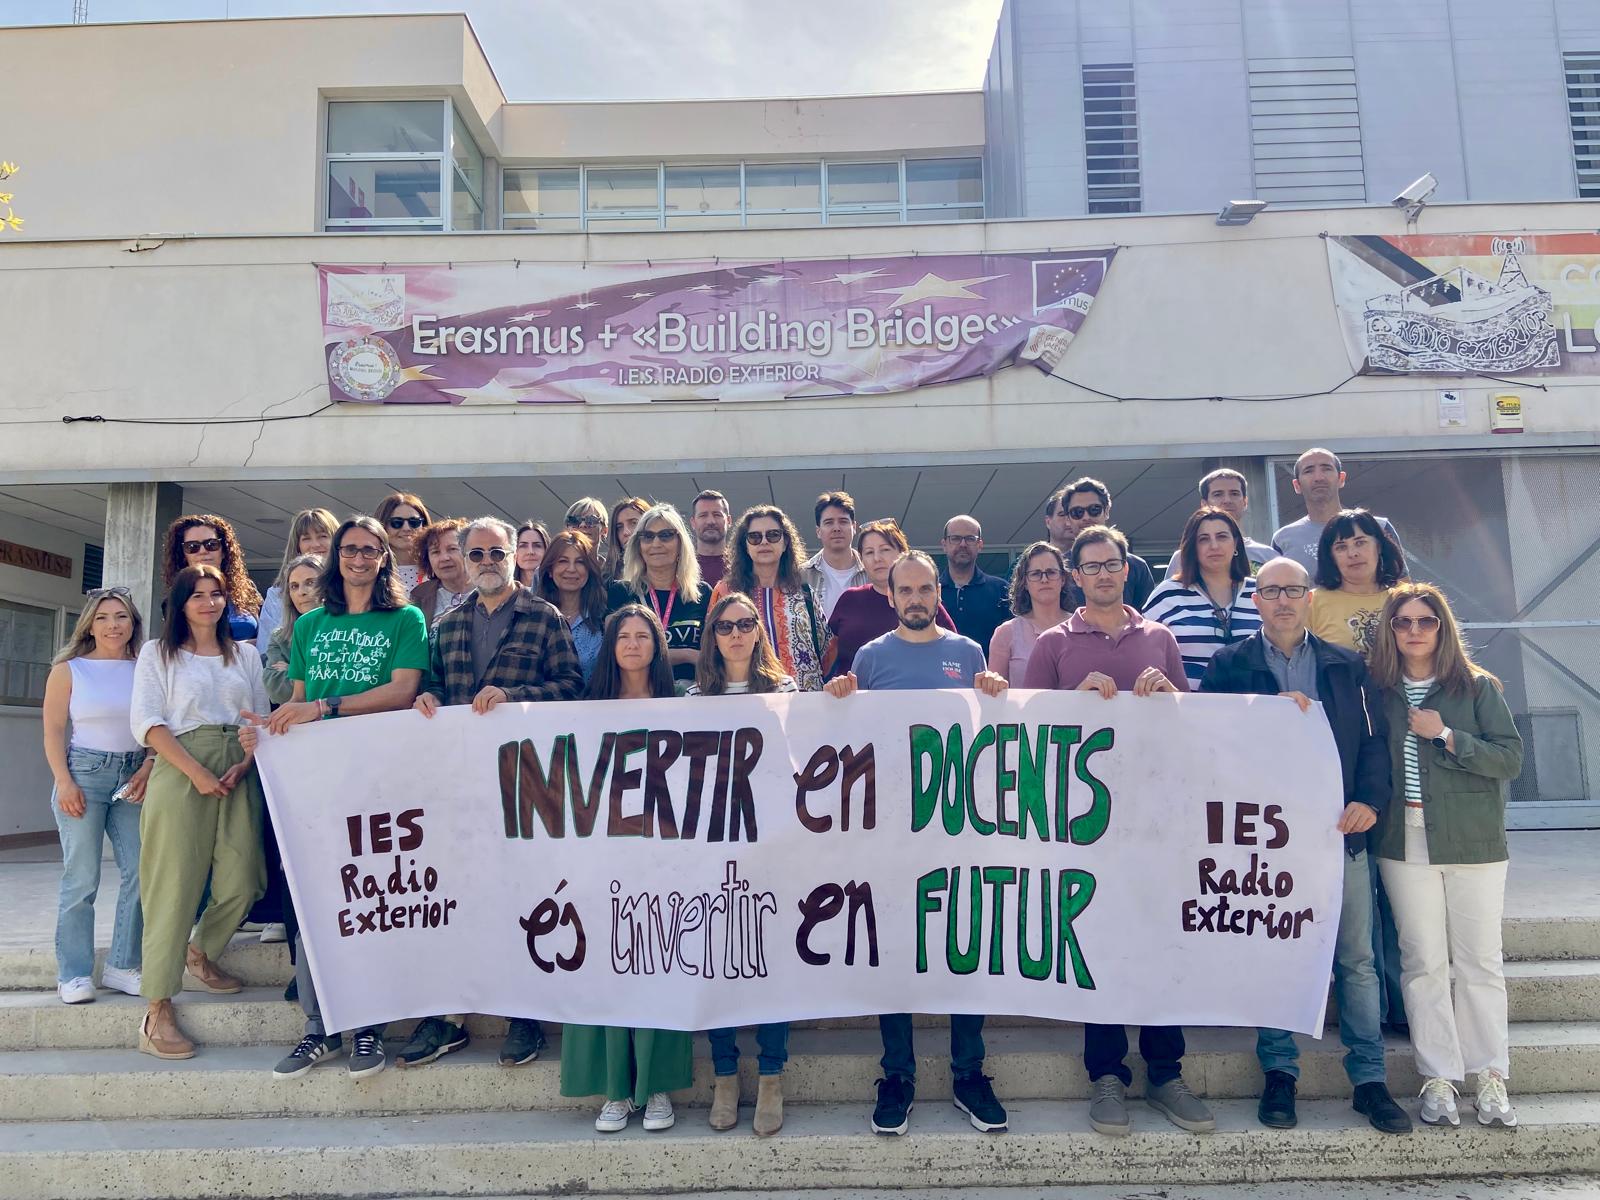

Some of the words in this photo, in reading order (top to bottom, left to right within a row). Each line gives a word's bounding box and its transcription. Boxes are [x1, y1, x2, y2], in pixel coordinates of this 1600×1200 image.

[411, 314, 584, 355] Erasmus
[598, 323, 618, 349] +
[1397, 319, 1452, 352] RADIO
[1456, 311, 1555, 360] EXTERIOR
[1563, 311, 1600, 354] L
[618, 367, 659, 385] I.E.S.
[663, 366, 724, 384] RADIO
[729, 364, 819, 383] EXTERIOR
[314, 630, 355, 644] ESCUELA
[318, 652, 337, 663] DE
[310, 668, 339, 681] PARA
[497, 727, 764, 842] INVERTIR
[792, 741, 877, 834] en
[908, 722, 1115, 845] DOCENTS
[346, 808, 425, 857] IES
[1204, 801, 1290, 850] IES
[340, 855, 439, 903] Radio
[1197, 853, 1294, 898] Radio
[337, 896, 457, 937] Exterior
[519, 879, 587, 973] és
[609, 860, 778, 979] invertir
[795, 879, 880, 967] en
[915, 865, 1097, 990] FUTUR
[1181, 896, 1315, 940] Exterior
